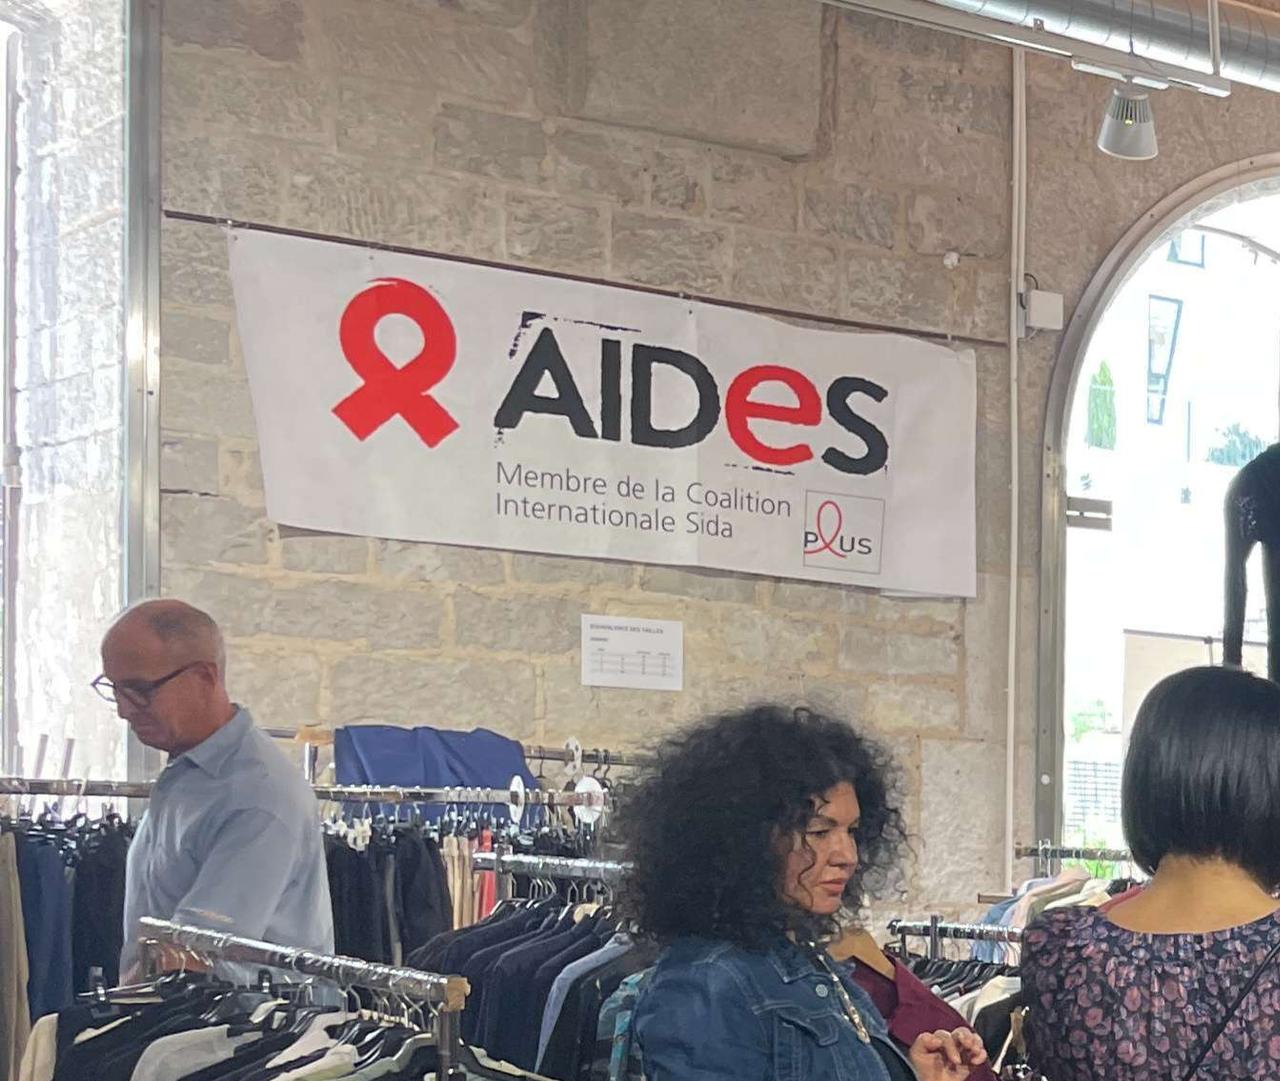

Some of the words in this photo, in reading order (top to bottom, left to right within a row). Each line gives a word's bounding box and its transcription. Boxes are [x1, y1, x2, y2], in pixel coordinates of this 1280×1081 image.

[496, 461, 607, 496] Membre
[616, 475, 645, 500] de
[655, 478, 676, 503] la
[686, 482, 791, 517] Coalition
[495, 492, 676, 533] Internationale
[685, 511, 733, 539] Sida
